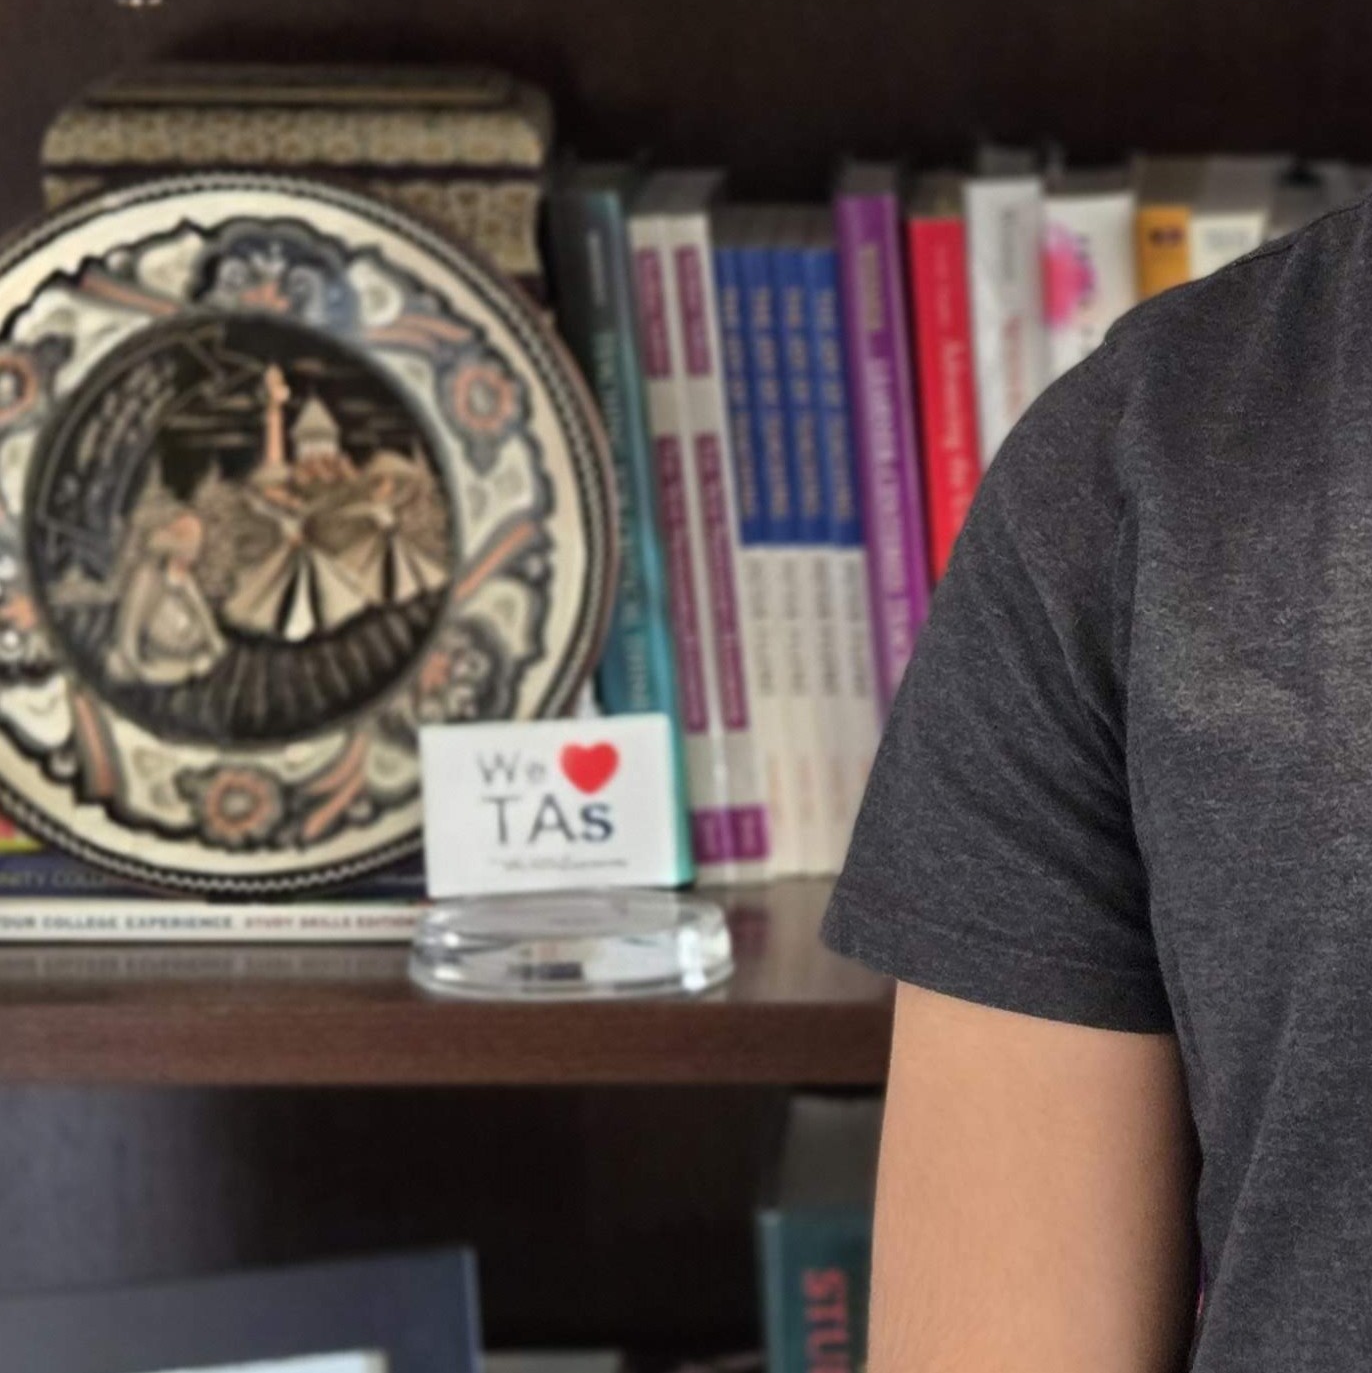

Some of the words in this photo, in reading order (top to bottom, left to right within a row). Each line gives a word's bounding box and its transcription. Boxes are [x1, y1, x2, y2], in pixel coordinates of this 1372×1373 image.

[475, 749, 546, 786] We
[480, 793, 615, 845] TAs
[0, 916, 36, 929] OUR
[42, 916, 118, 929] COLLEGE
[124, 916, 232, 929] EXPERIENCE
[801, 1267, 849, 1373] STU
